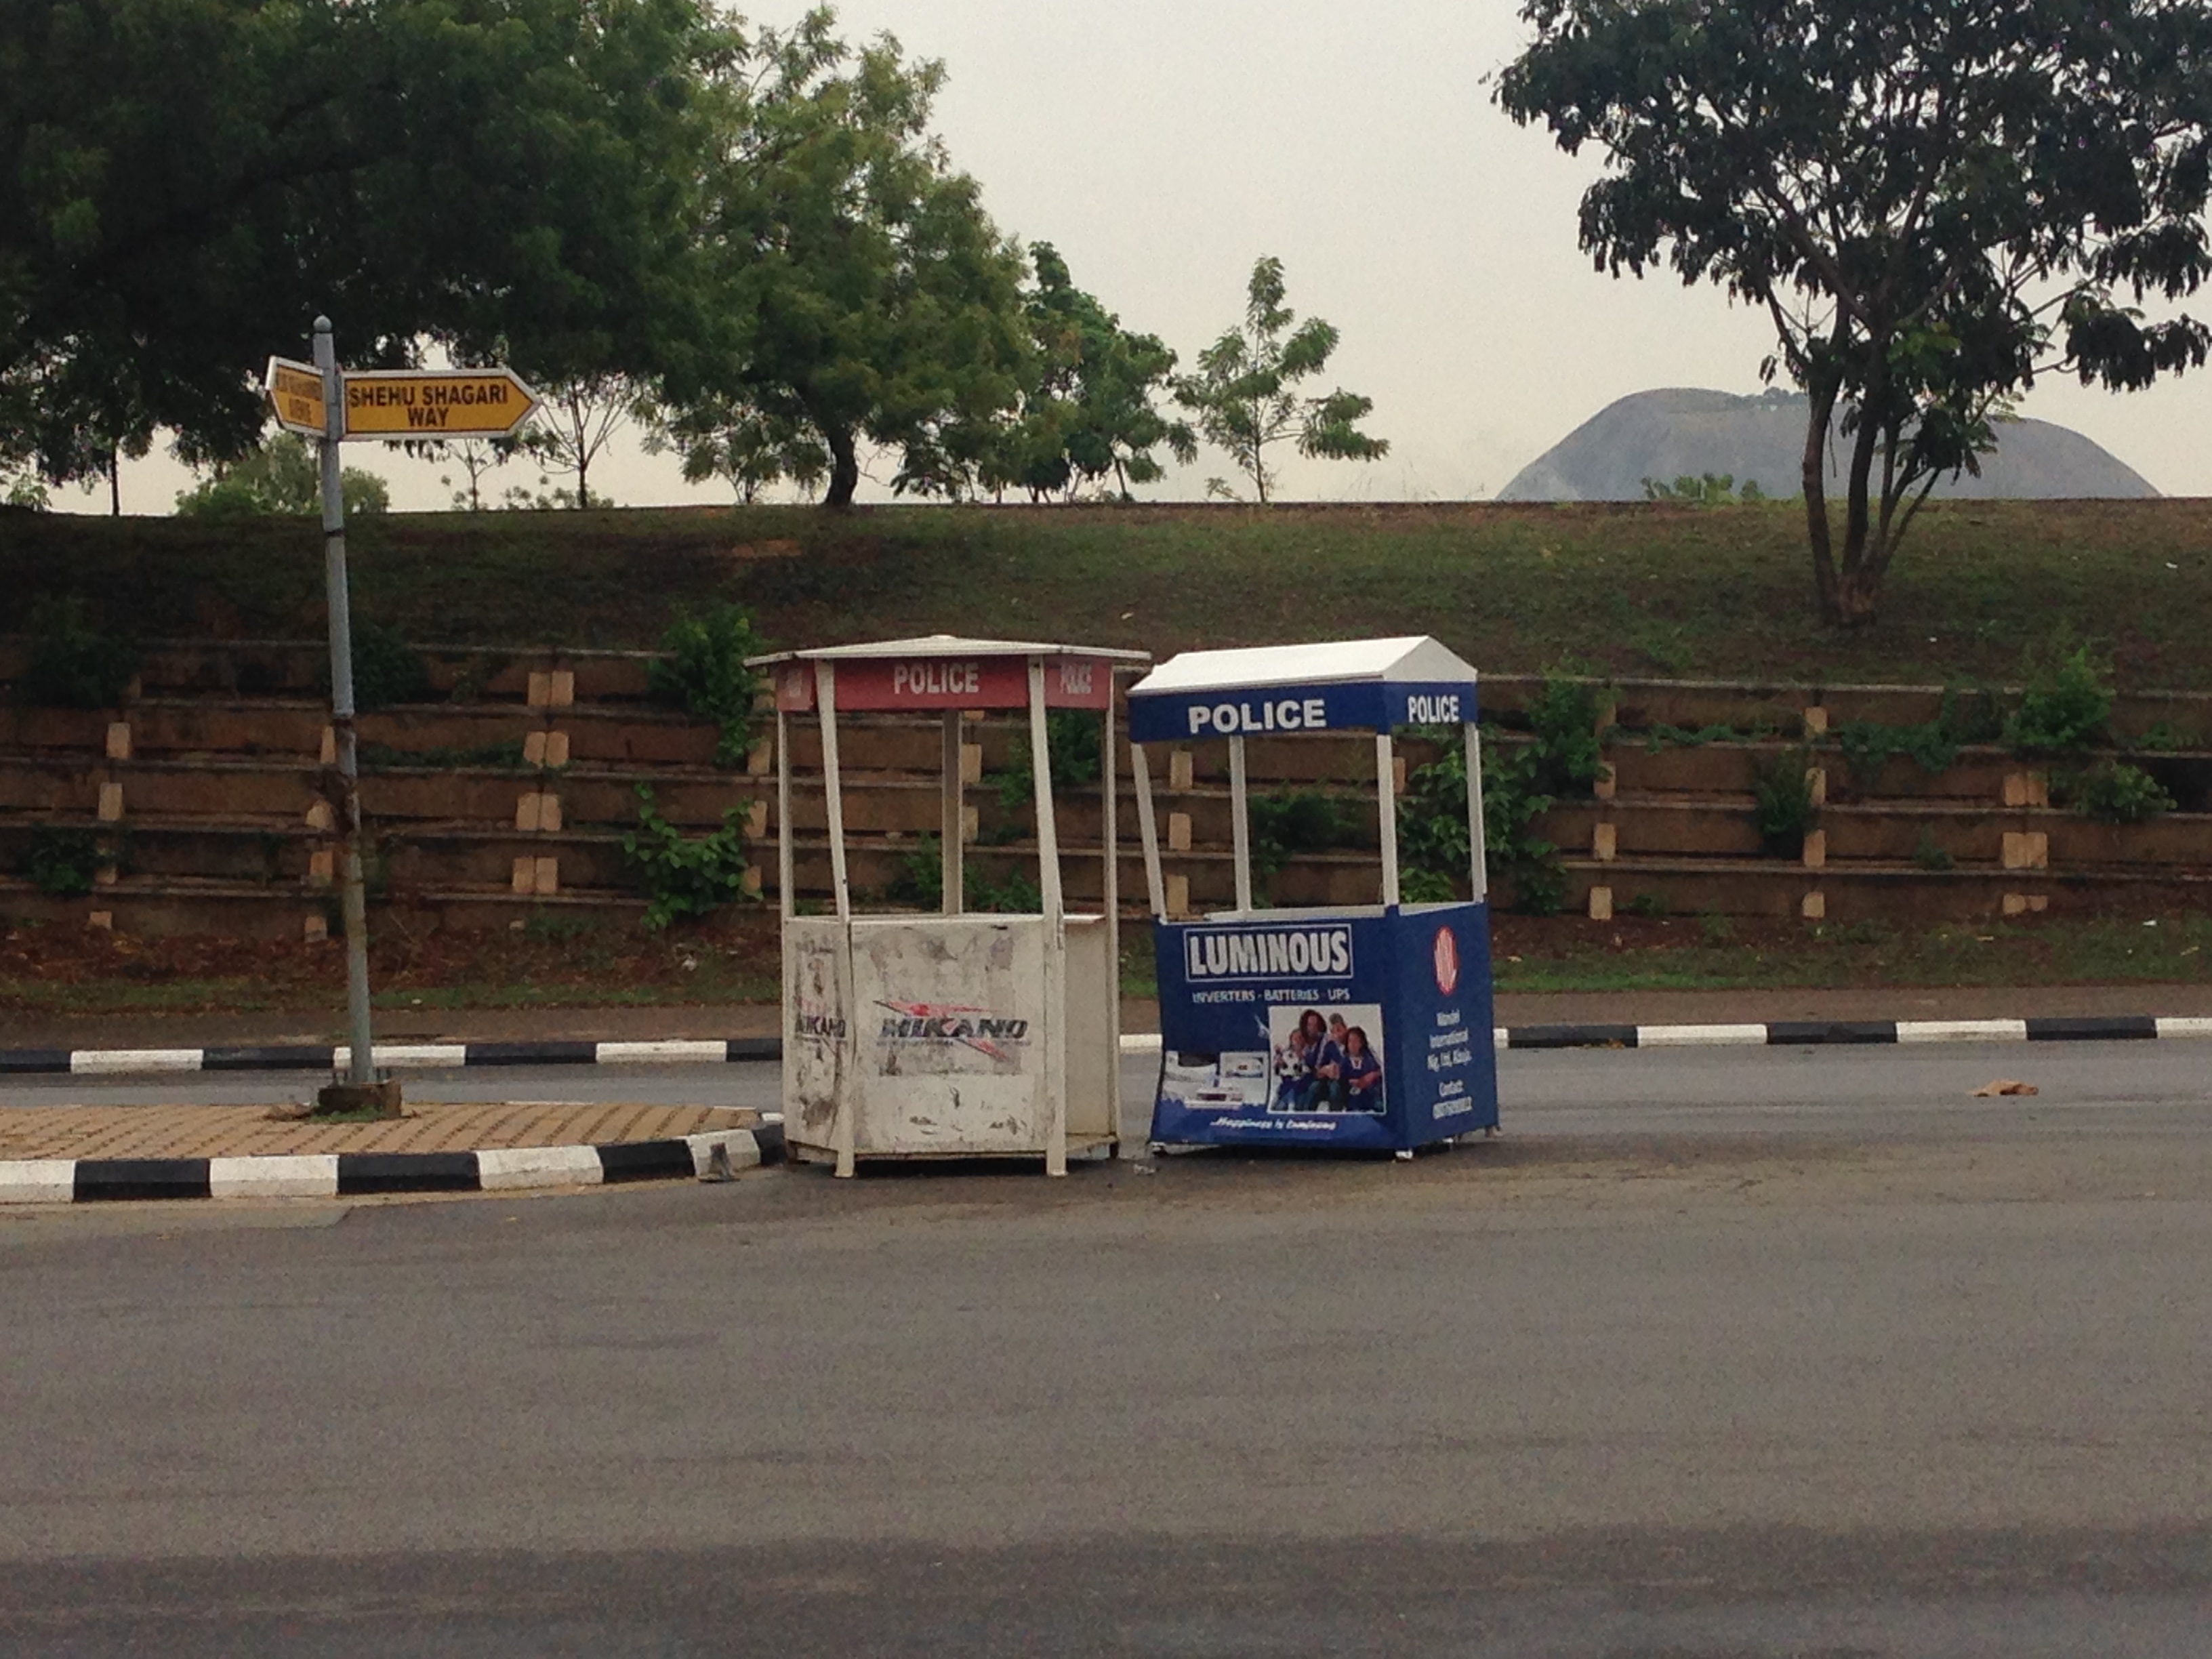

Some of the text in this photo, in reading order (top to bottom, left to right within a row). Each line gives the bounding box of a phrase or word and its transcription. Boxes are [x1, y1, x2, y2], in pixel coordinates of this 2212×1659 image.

[349, 386, 415, 408] SHEHU
[422, 384, 509, 406] SHAGARI
[407, 407, 449, 427] WAY
[894, 662, 979, 695] POLICE
[1189, 698, 1327, 734] POLICE
[1407, 695, 1460, 723] POLICE
[1189, 931, 1349, 976] LUMINOUS
[1192, 987, 1351, 1004] INVERTERS BATTERIES UPS
